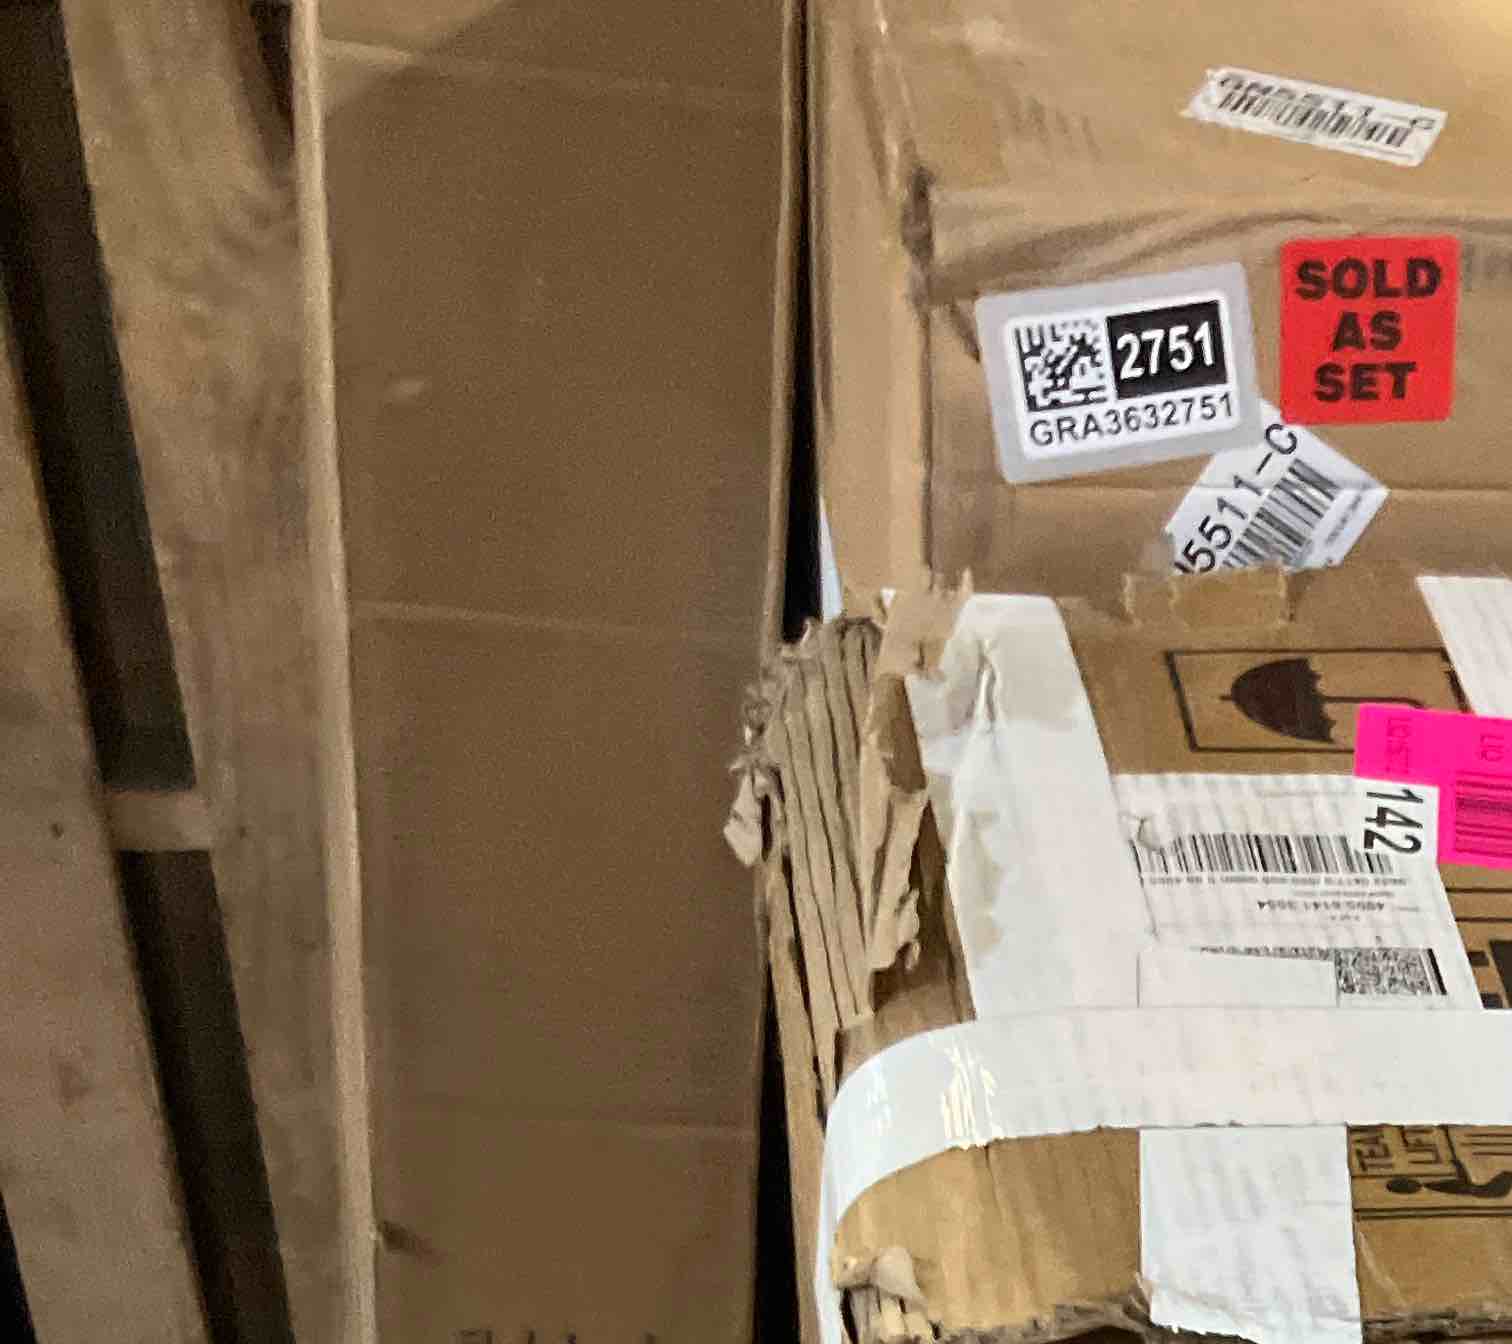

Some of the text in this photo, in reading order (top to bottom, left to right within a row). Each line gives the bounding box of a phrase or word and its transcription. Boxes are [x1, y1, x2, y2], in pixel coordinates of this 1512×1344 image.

[1295, 257, 1442, 300] SOLD
[1115, 320, 1218, 386] 2751
[1331, 310, 1403, 352] AS
[1314, 362, 1417, 403] SET
[1029, 392, 1233, 446] GRA3632751
[1363, 788, 1424, 856] 142
